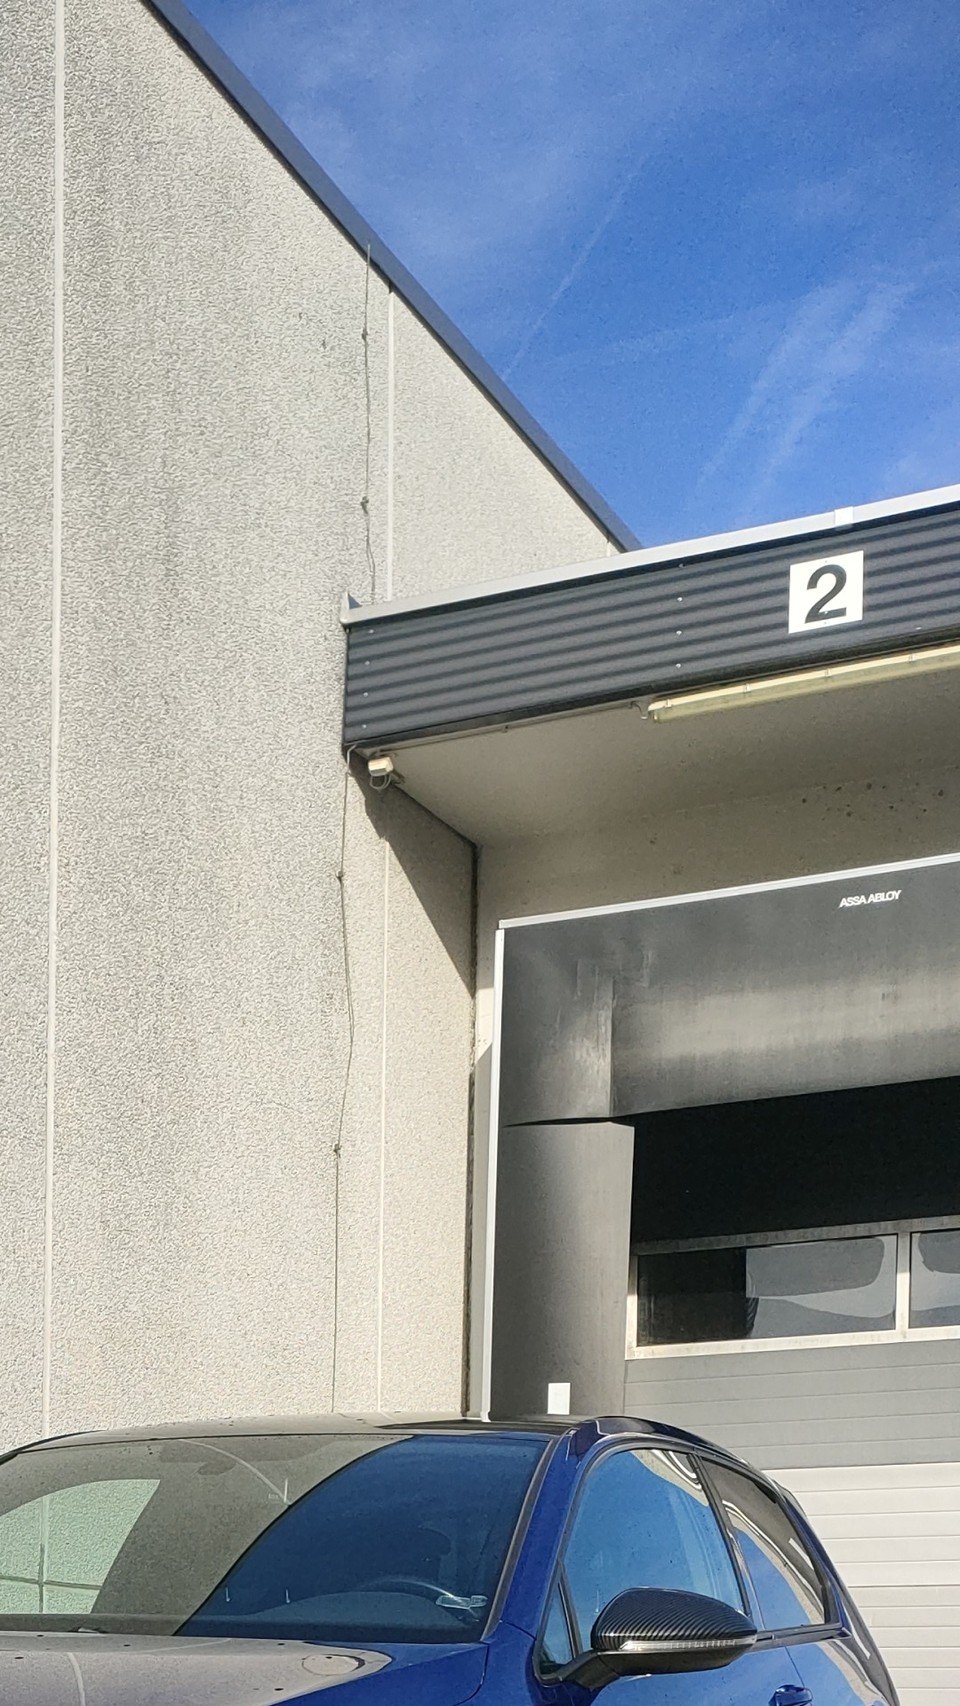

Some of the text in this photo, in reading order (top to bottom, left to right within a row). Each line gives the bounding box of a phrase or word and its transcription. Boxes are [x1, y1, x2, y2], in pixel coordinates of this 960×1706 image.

[805, 564, 847, 624] 2
[839, 889, 902, 908] ASSA ABLOY
